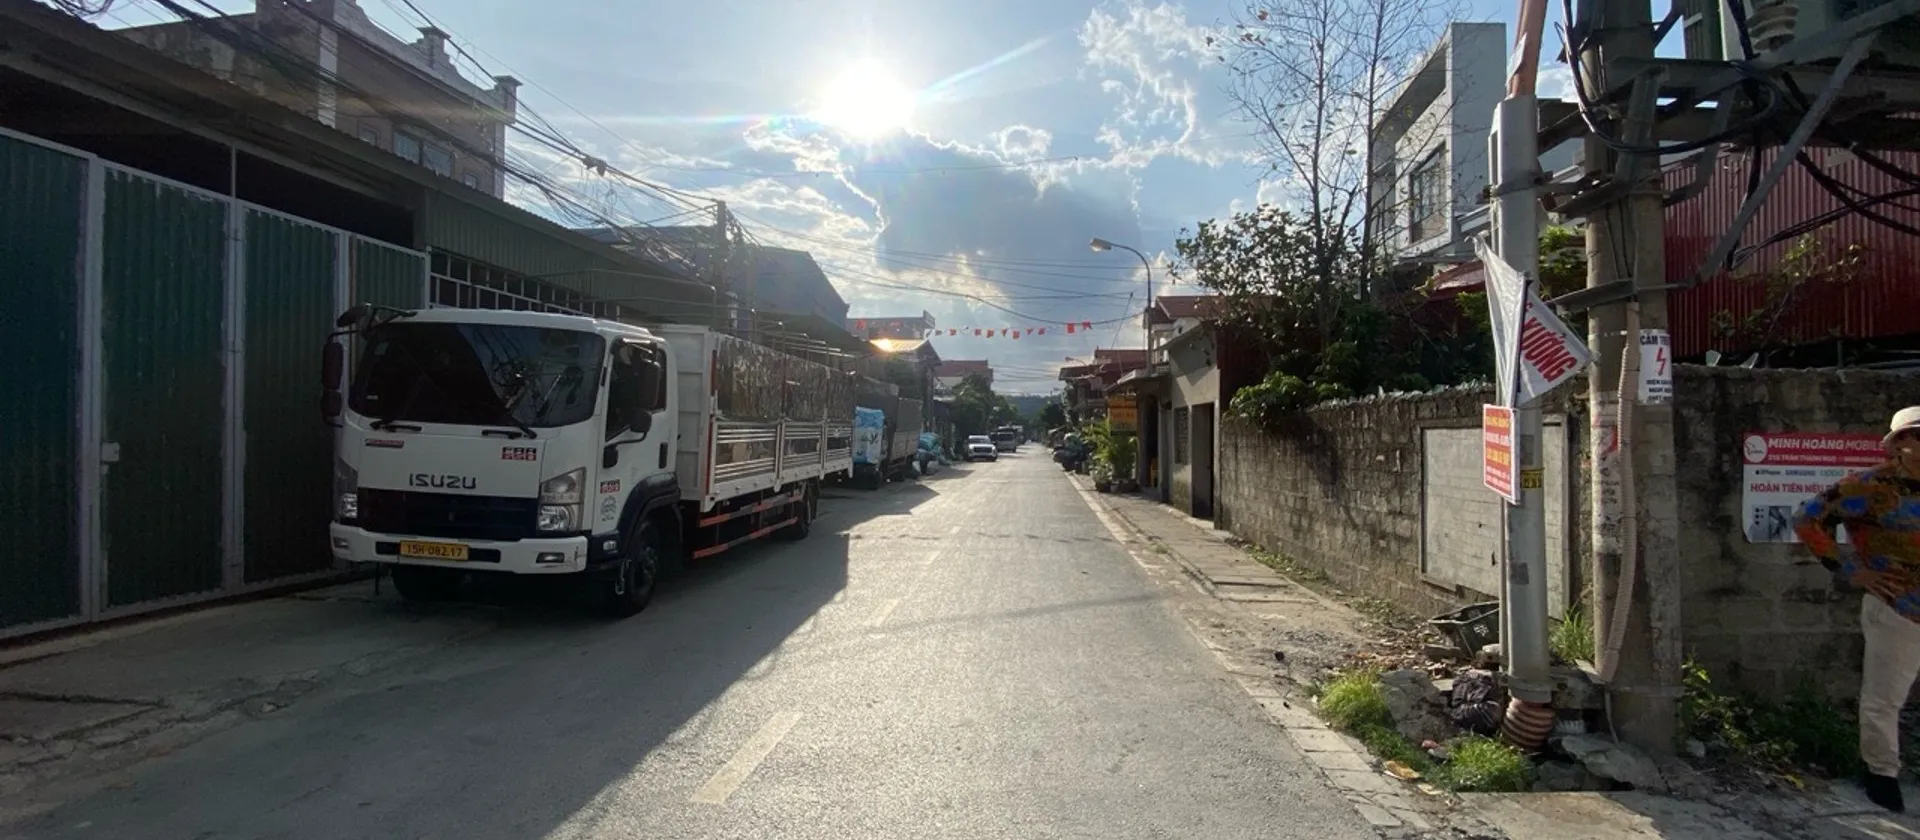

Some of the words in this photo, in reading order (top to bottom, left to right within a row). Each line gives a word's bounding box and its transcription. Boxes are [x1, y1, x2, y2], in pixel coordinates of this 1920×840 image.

[1768, 438, 1800, 449] MINH
[1801, 436, 1843, 450] HOÀNG
[409, 472, 476, 490] ISUZU
[1751, 482, 1780, 492] HOÀN
